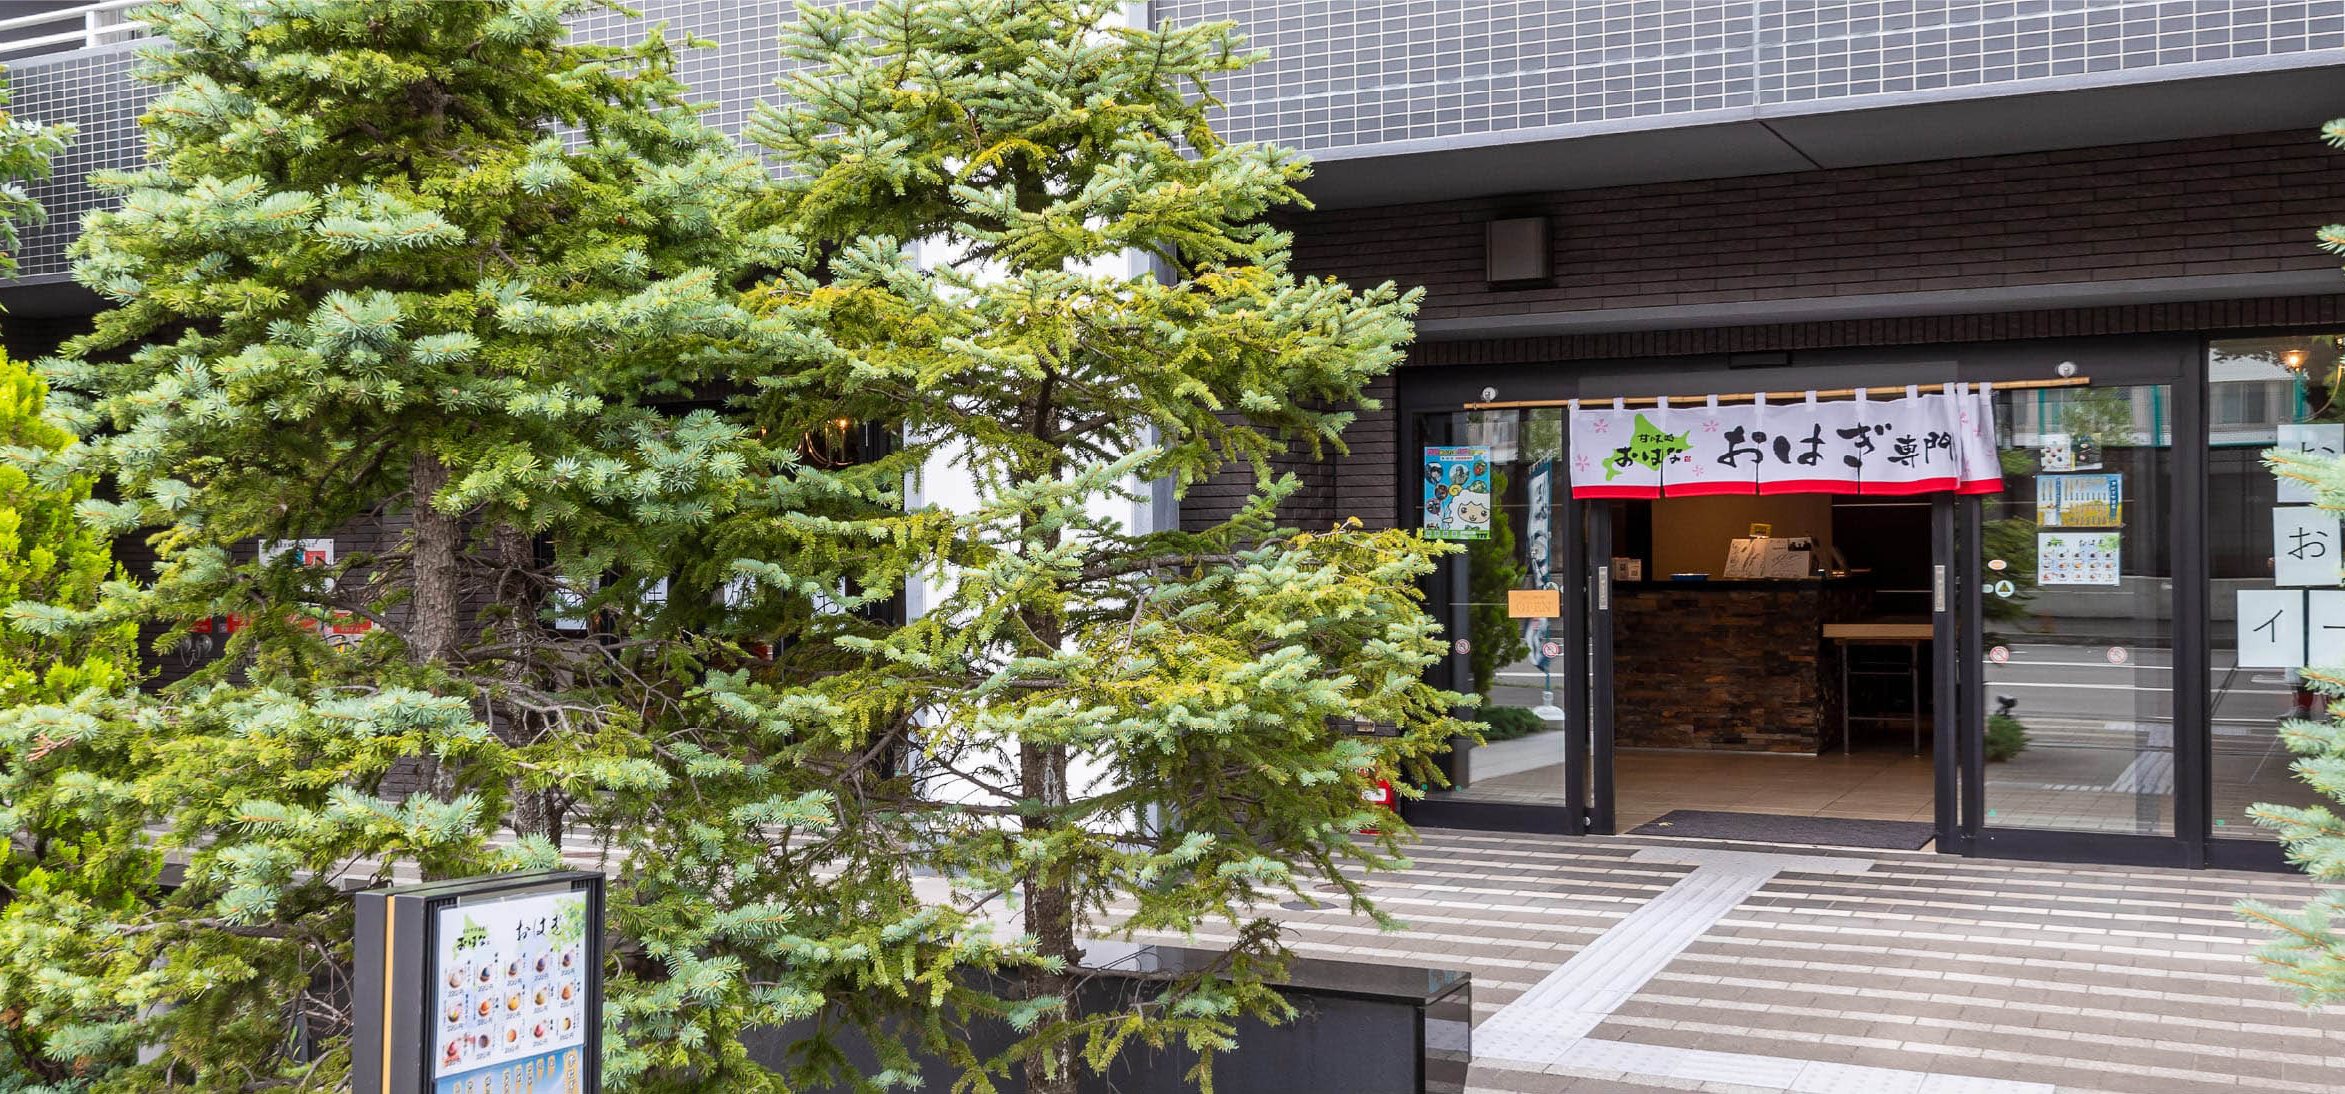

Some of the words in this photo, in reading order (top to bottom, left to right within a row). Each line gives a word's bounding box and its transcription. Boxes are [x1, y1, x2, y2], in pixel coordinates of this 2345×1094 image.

[1615, 446, 1683, 467] おはな
[2287, 527, 2328, 560] お
